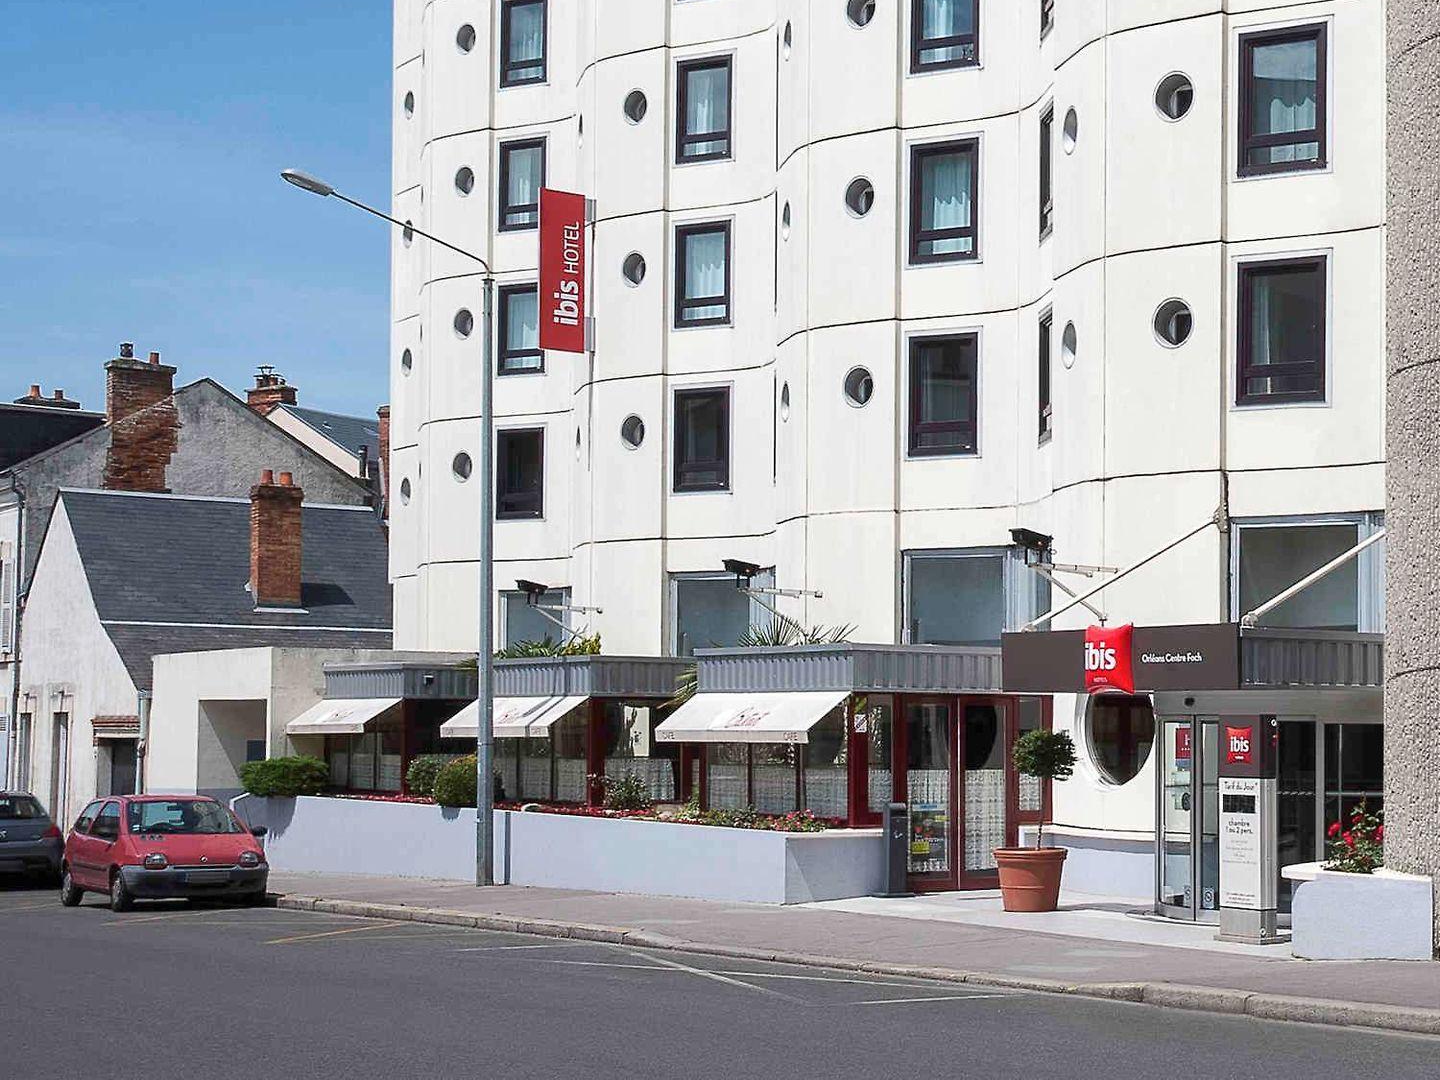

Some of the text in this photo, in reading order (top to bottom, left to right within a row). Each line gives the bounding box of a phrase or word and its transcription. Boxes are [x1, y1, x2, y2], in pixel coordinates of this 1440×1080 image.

[553, 221, 580, 326] ibis HOTEL
[1084, 641, 1117, 670] ibis
[1165, 652, 1186, 663] Centre
[1187, 651, 1203, 662] Foch
[1230, 736, 1250, 752] ibis
